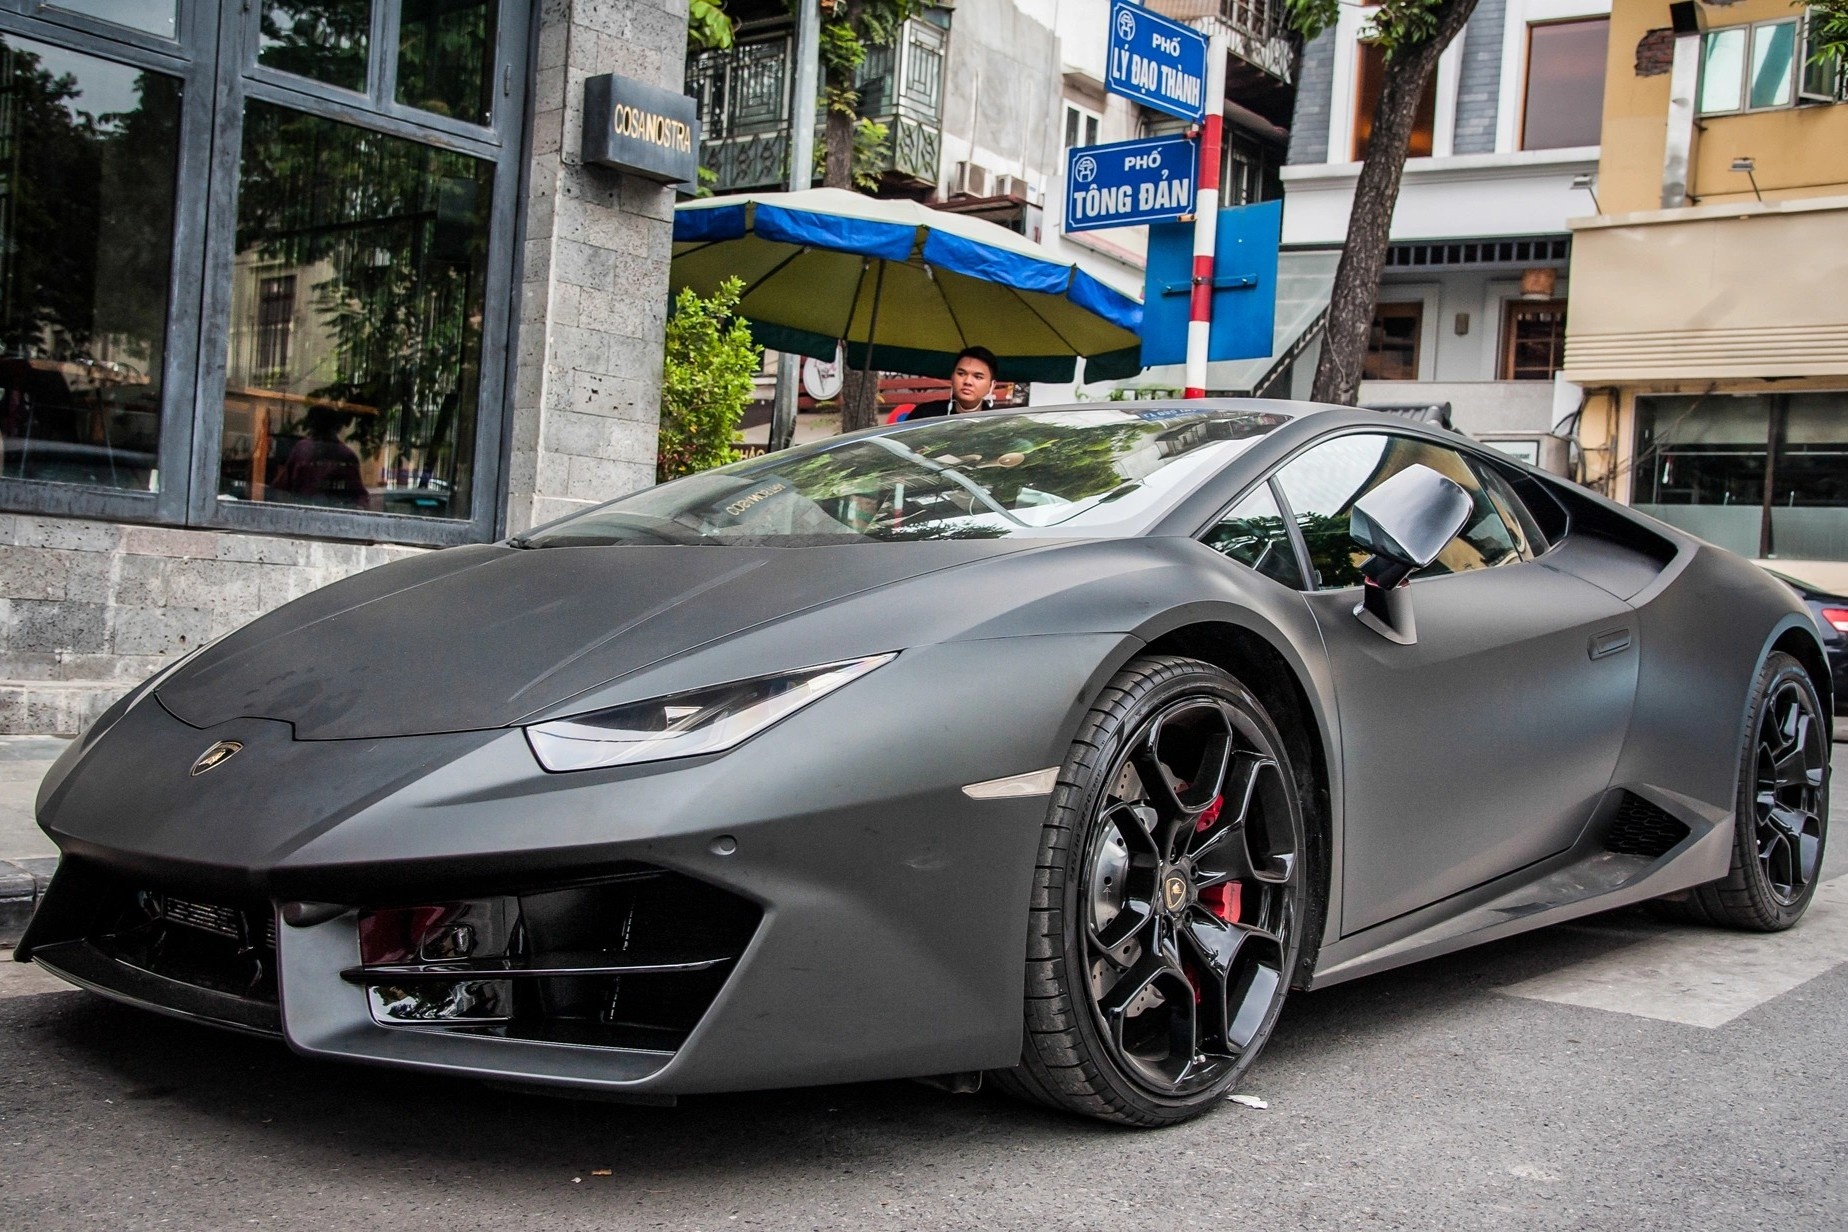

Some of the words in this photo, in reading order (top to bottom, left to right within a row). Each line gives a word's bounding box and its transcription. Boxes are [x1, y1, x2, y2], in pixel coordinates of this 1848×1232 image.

[1152, 33, 1181, 57] PHỐ
[1112, 43, 1130, 81] LÝ
[1131, 54, 1158, 94] ĐẠO
[1161, 64, 1200, 108] THÀNH
[614, 104, 691, 154] COSANOSTRA
[1124, 147, 1163, 171] PHỐ
[1074, 184, 1132, 219] TÔNG
[1139, 169, 1190, 211] ĐẢN
